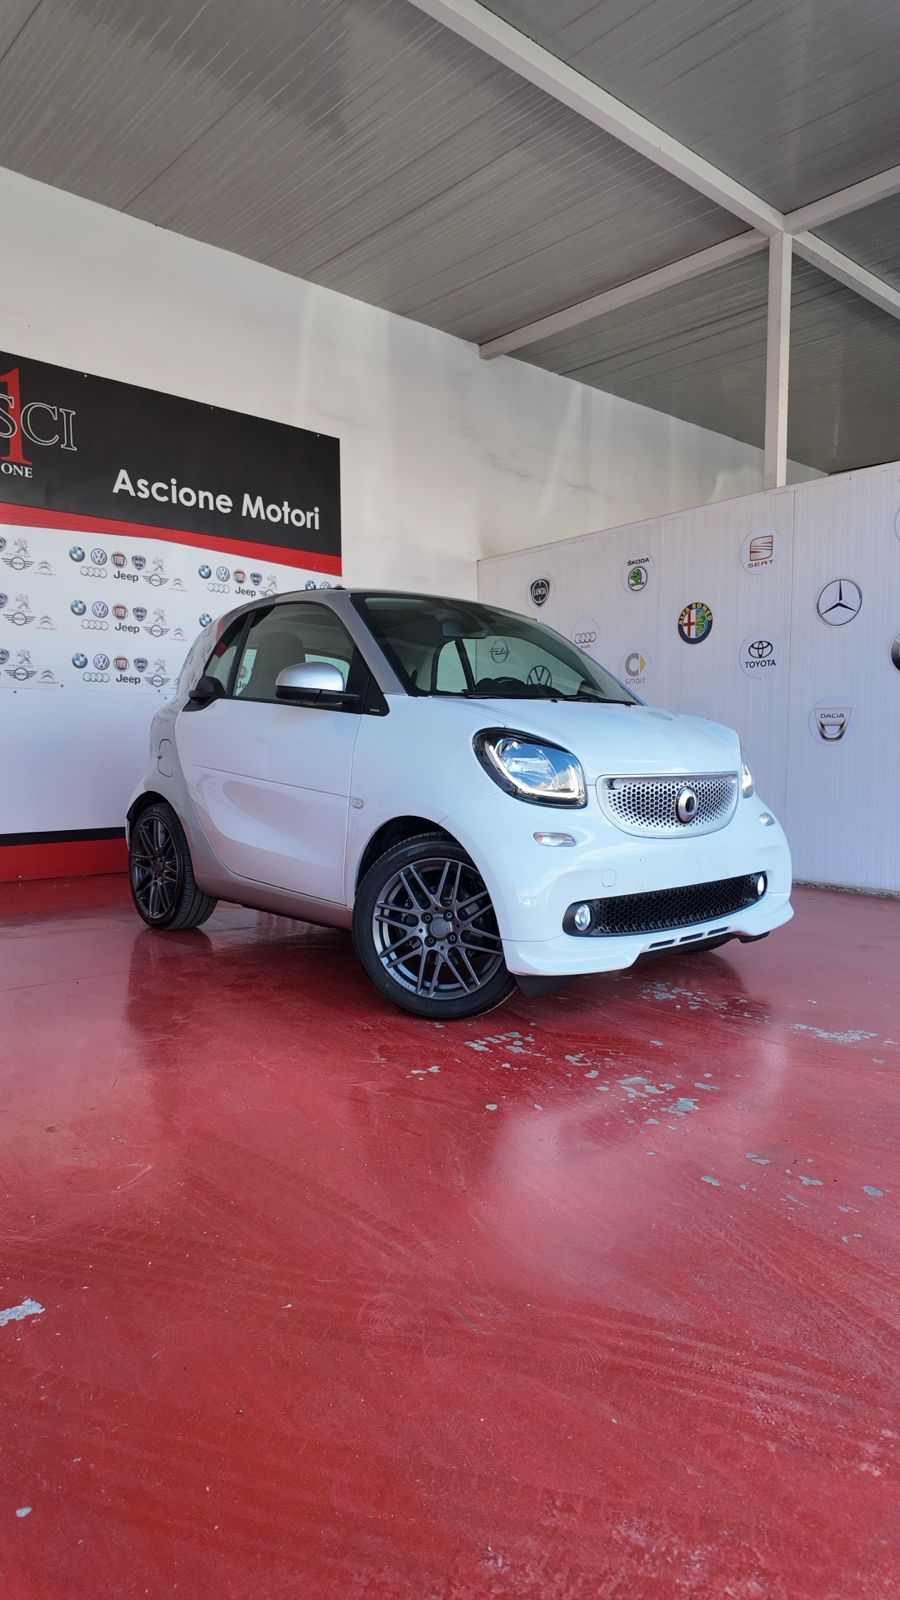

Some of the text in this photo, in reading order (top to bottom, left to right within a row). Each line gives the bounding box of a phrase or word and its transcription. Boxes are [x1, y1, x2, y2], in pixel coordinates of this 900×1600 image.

[0, 462, 33, 478] ONE
[112, 469, 320, 530] Ascione Motori
[747, 559, 774, 568] SEAT
[113, 570, 139, 583] Jeep
[235, 586, 256, 597] Jeep
[114, 622, 140, 634] Jeep
[745, 659, 776, 668] TOYOTA
[115, 673, 141, 685] Jeep
